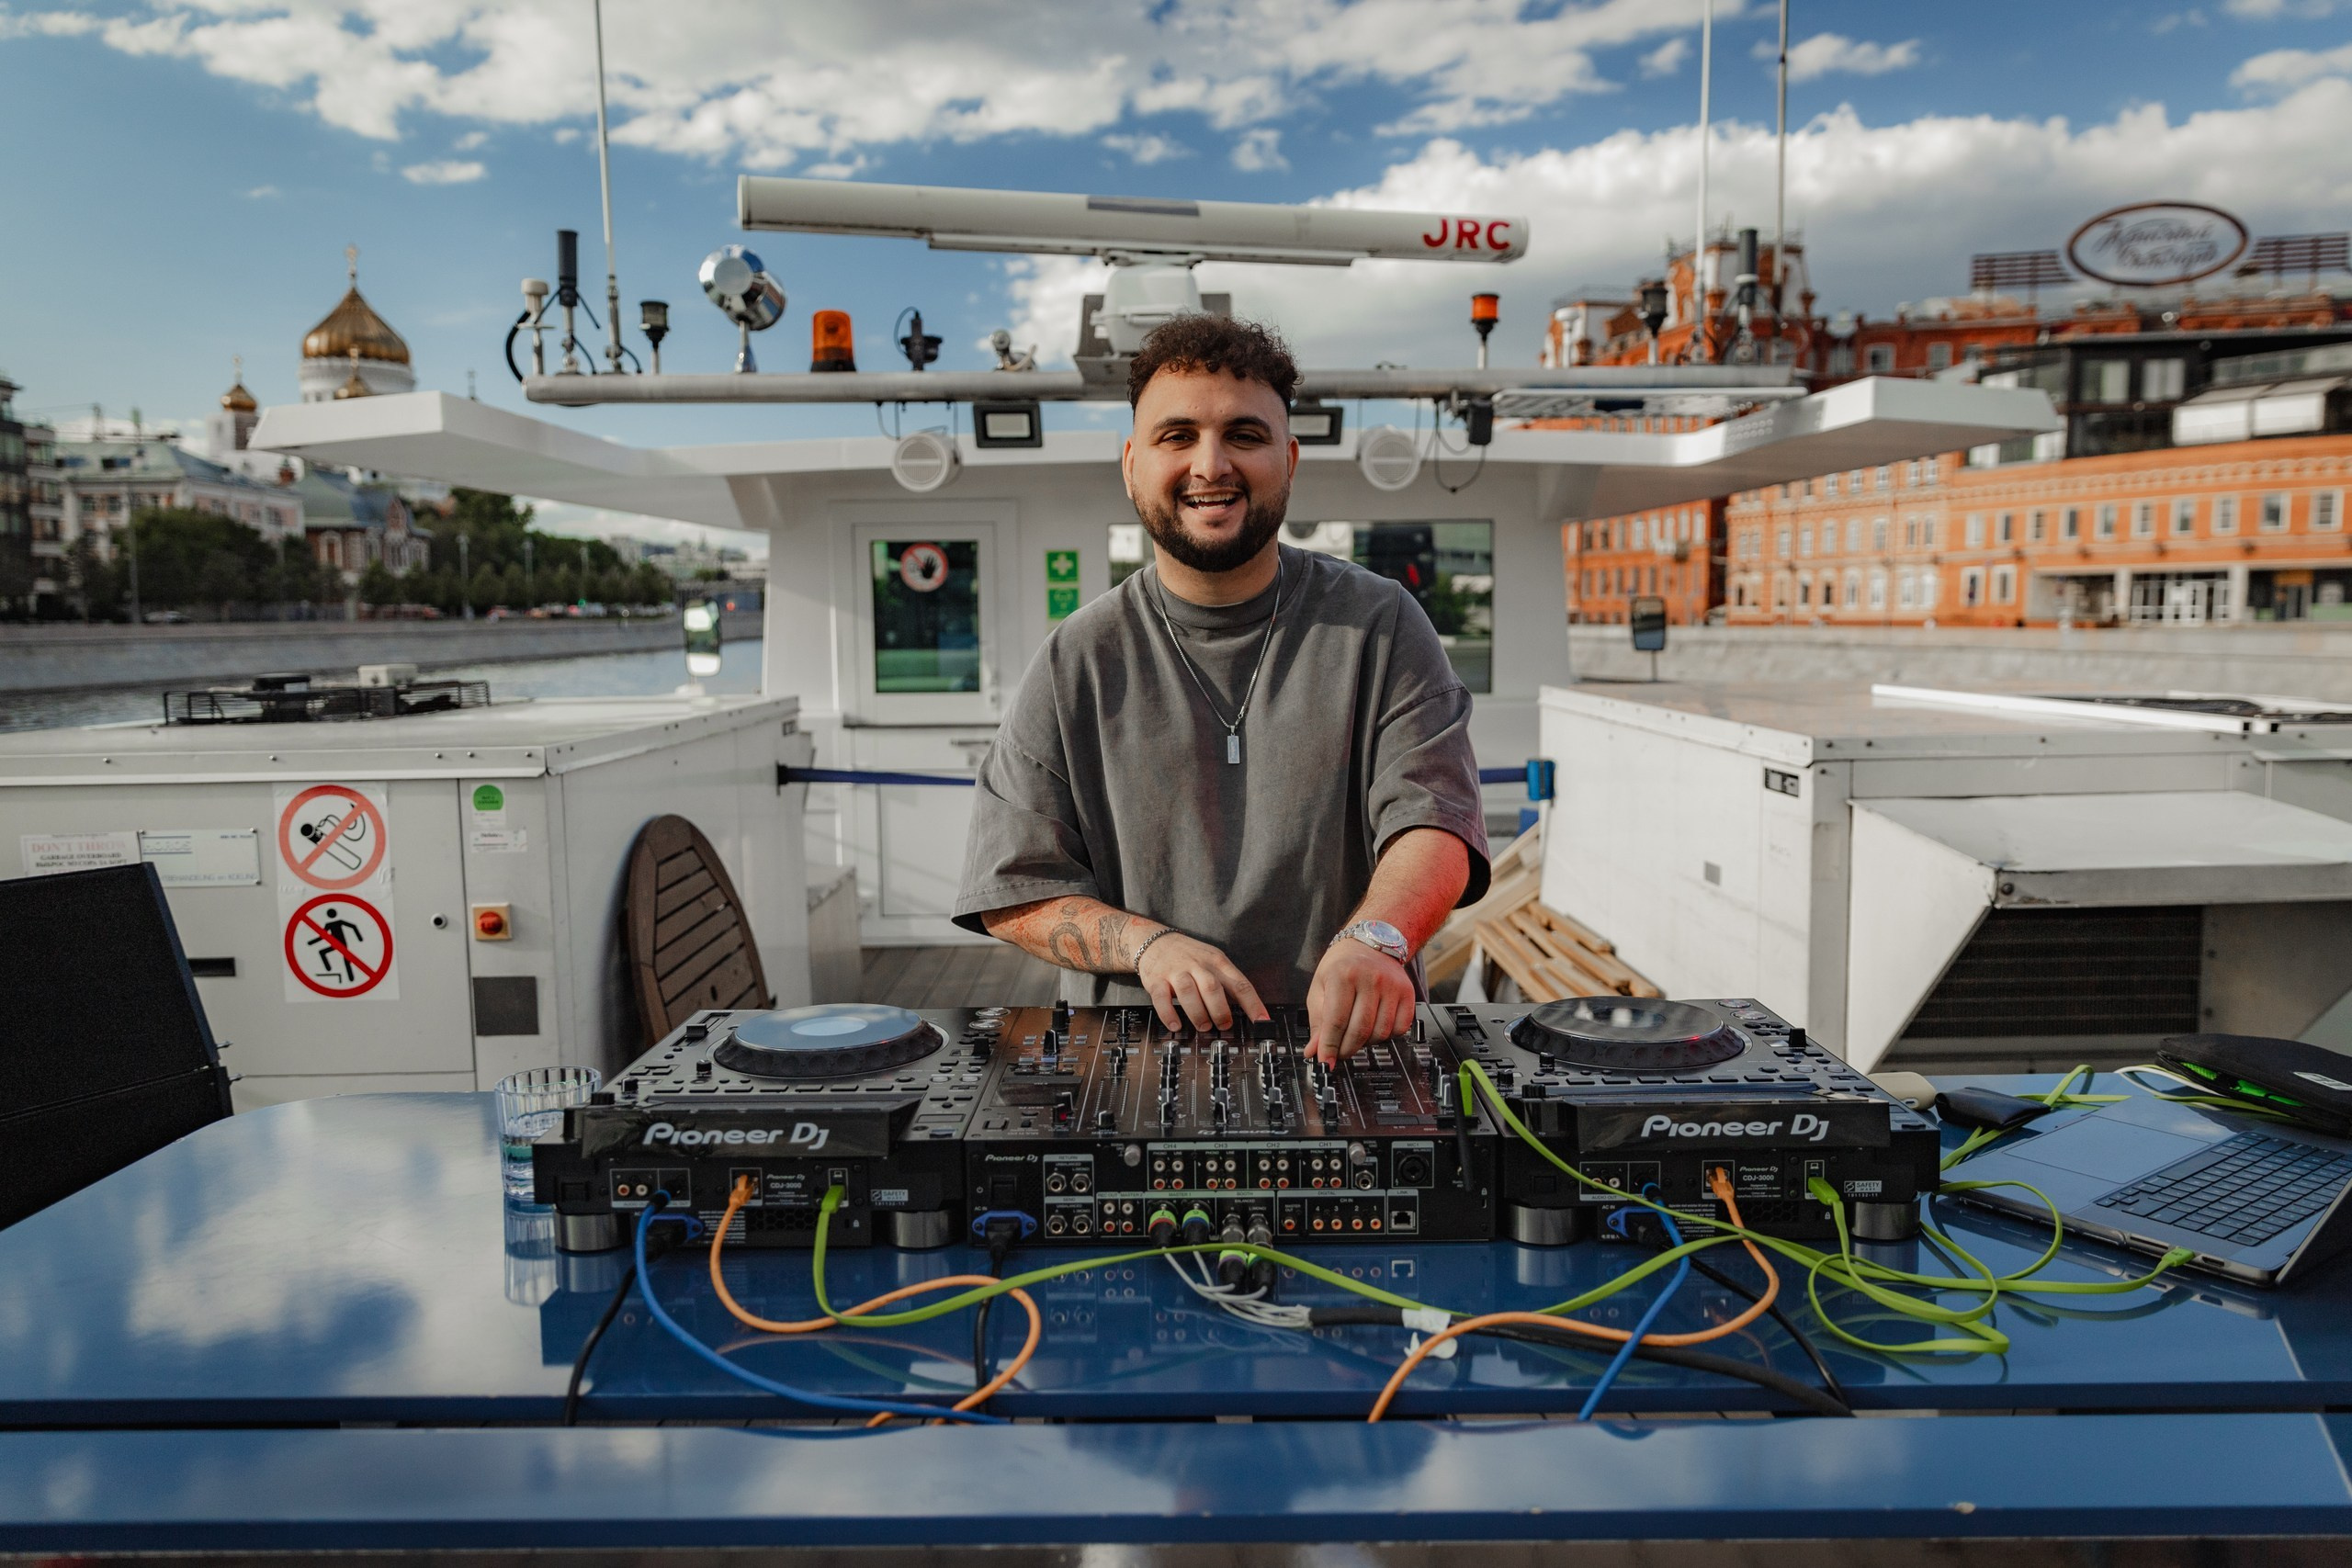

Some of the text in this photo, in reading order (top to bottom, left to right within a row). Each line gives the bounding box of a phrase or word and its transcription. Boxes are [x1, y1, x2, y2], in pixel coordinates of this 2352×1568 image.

[1423, 219, 1510, 251] JRC
[31, 840, 126, 852] DON'T THROW
[643, 1122, 784, 1145] Pioneer
[1641, 1114, 1782, 1137] Pioneer
